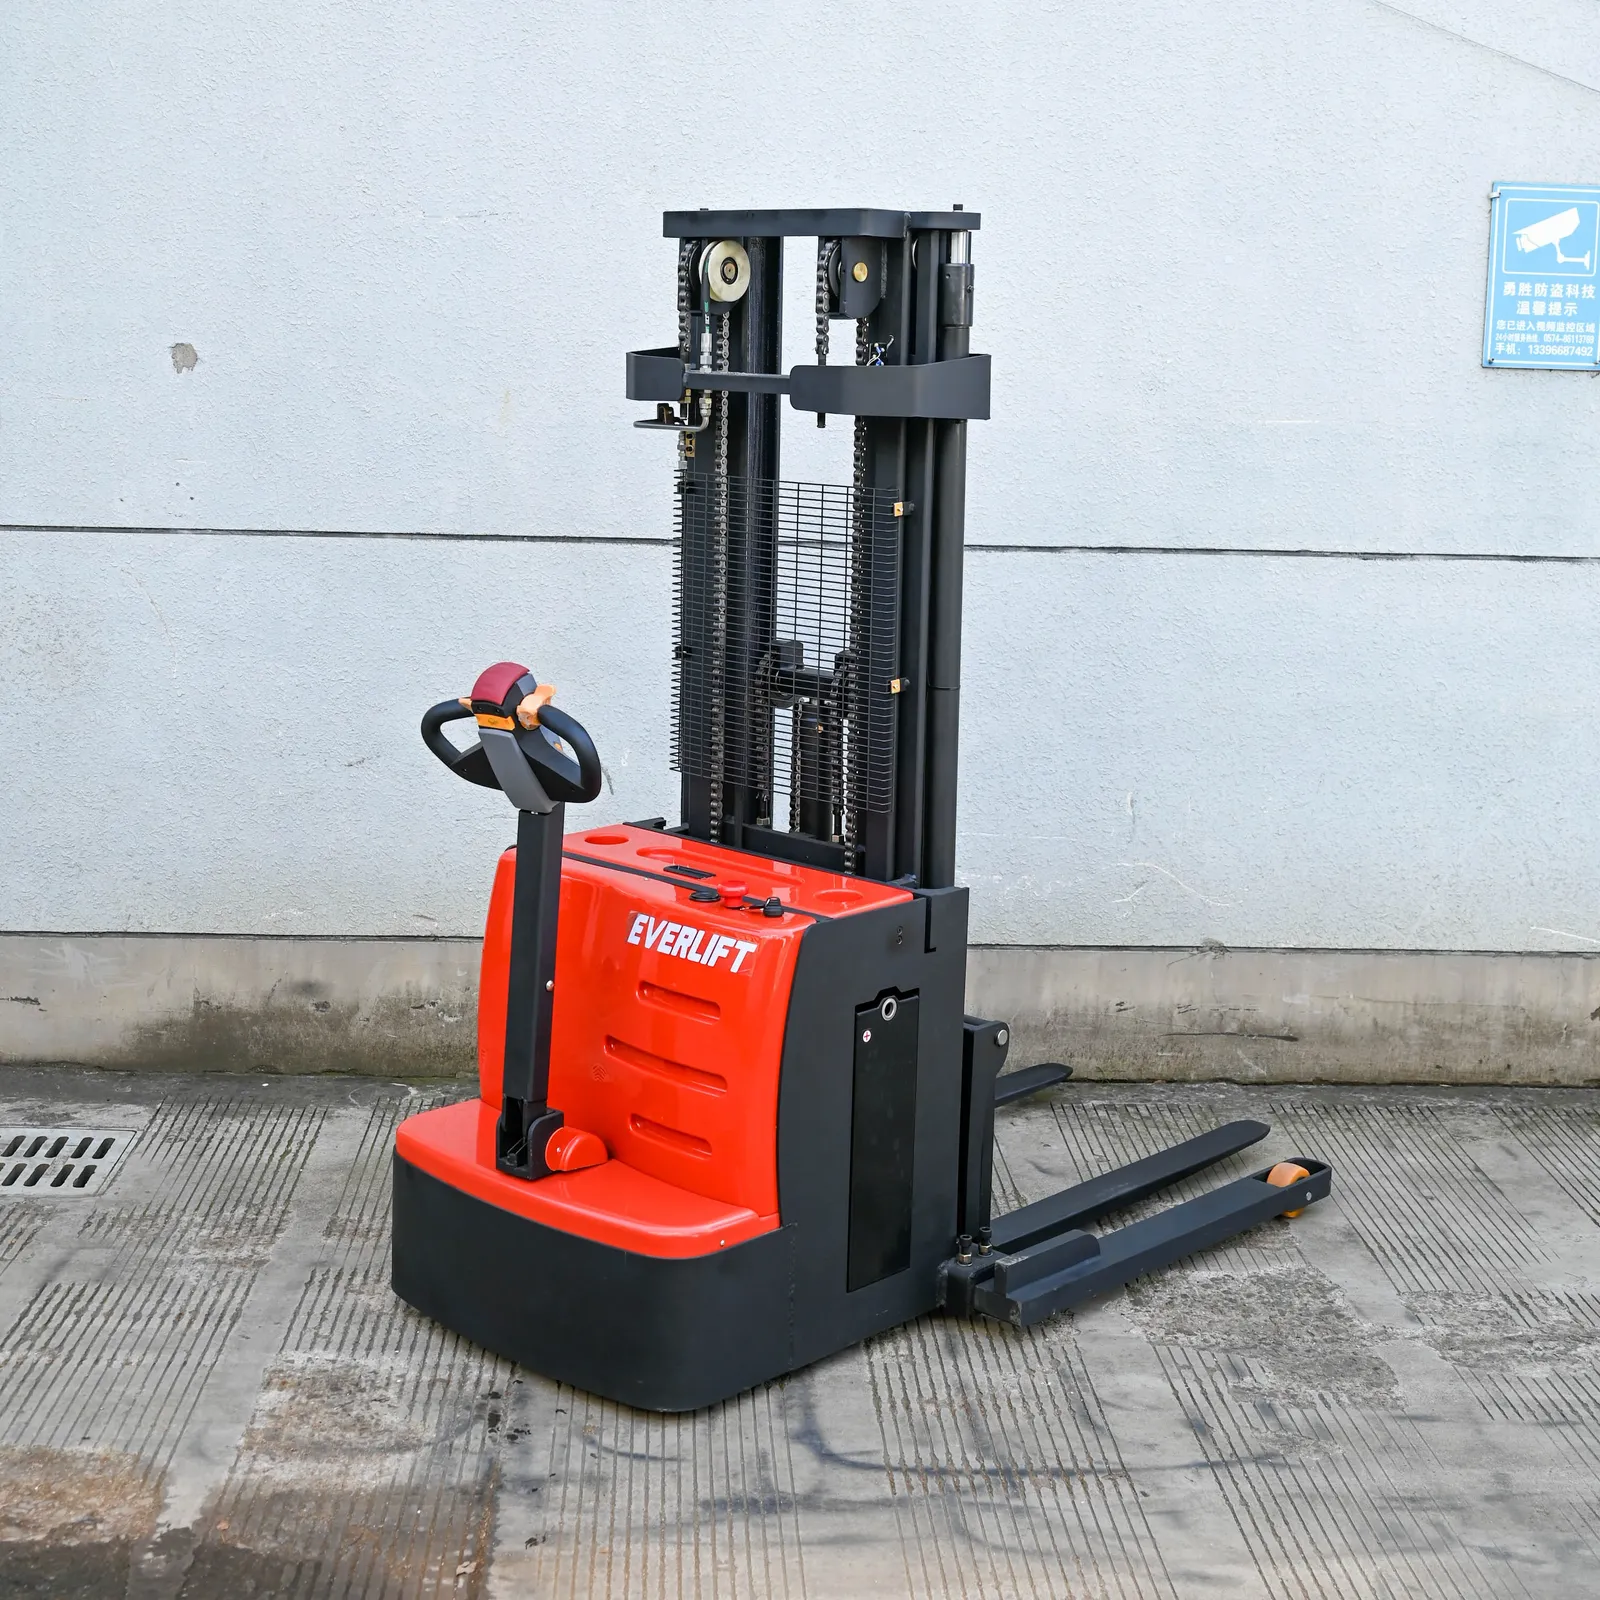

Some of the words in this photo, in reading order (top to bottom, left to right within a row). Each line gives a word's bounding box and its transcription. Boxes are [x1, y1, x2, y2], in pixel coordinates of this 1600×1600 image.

[1502, 281, 1597, 300] 勇胜防盗科技
[1516, 300, 1578, 317] 温馨提示
[1496, 319, 1596, 333] 您已进入视频监控区域
[627, 913, 758, 973] EVERLIFT
